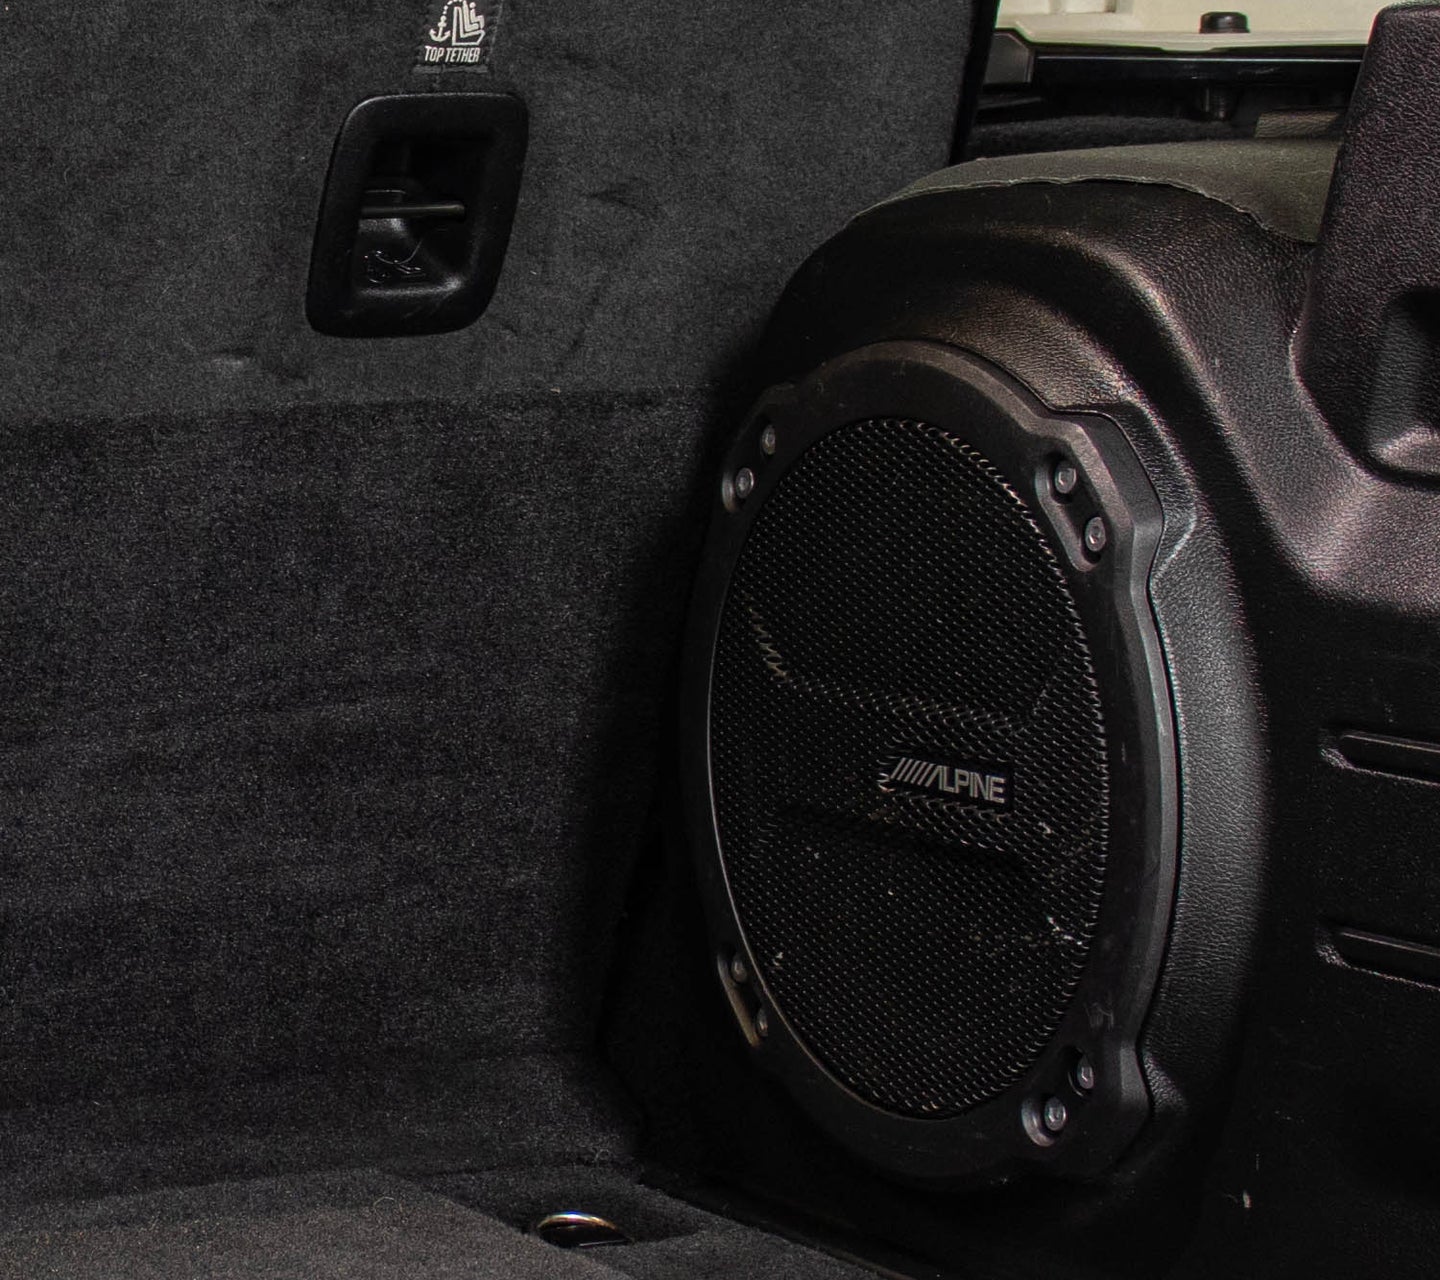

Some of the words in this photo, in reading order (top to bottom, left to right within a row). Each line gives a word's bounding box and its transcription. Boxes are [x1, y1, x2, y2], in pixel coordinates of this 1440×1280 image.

[424, 45, 445, 63] TOP
[445, 46, 481, 63] TETHER
[922, 763, 1006, 804] ALPINE
